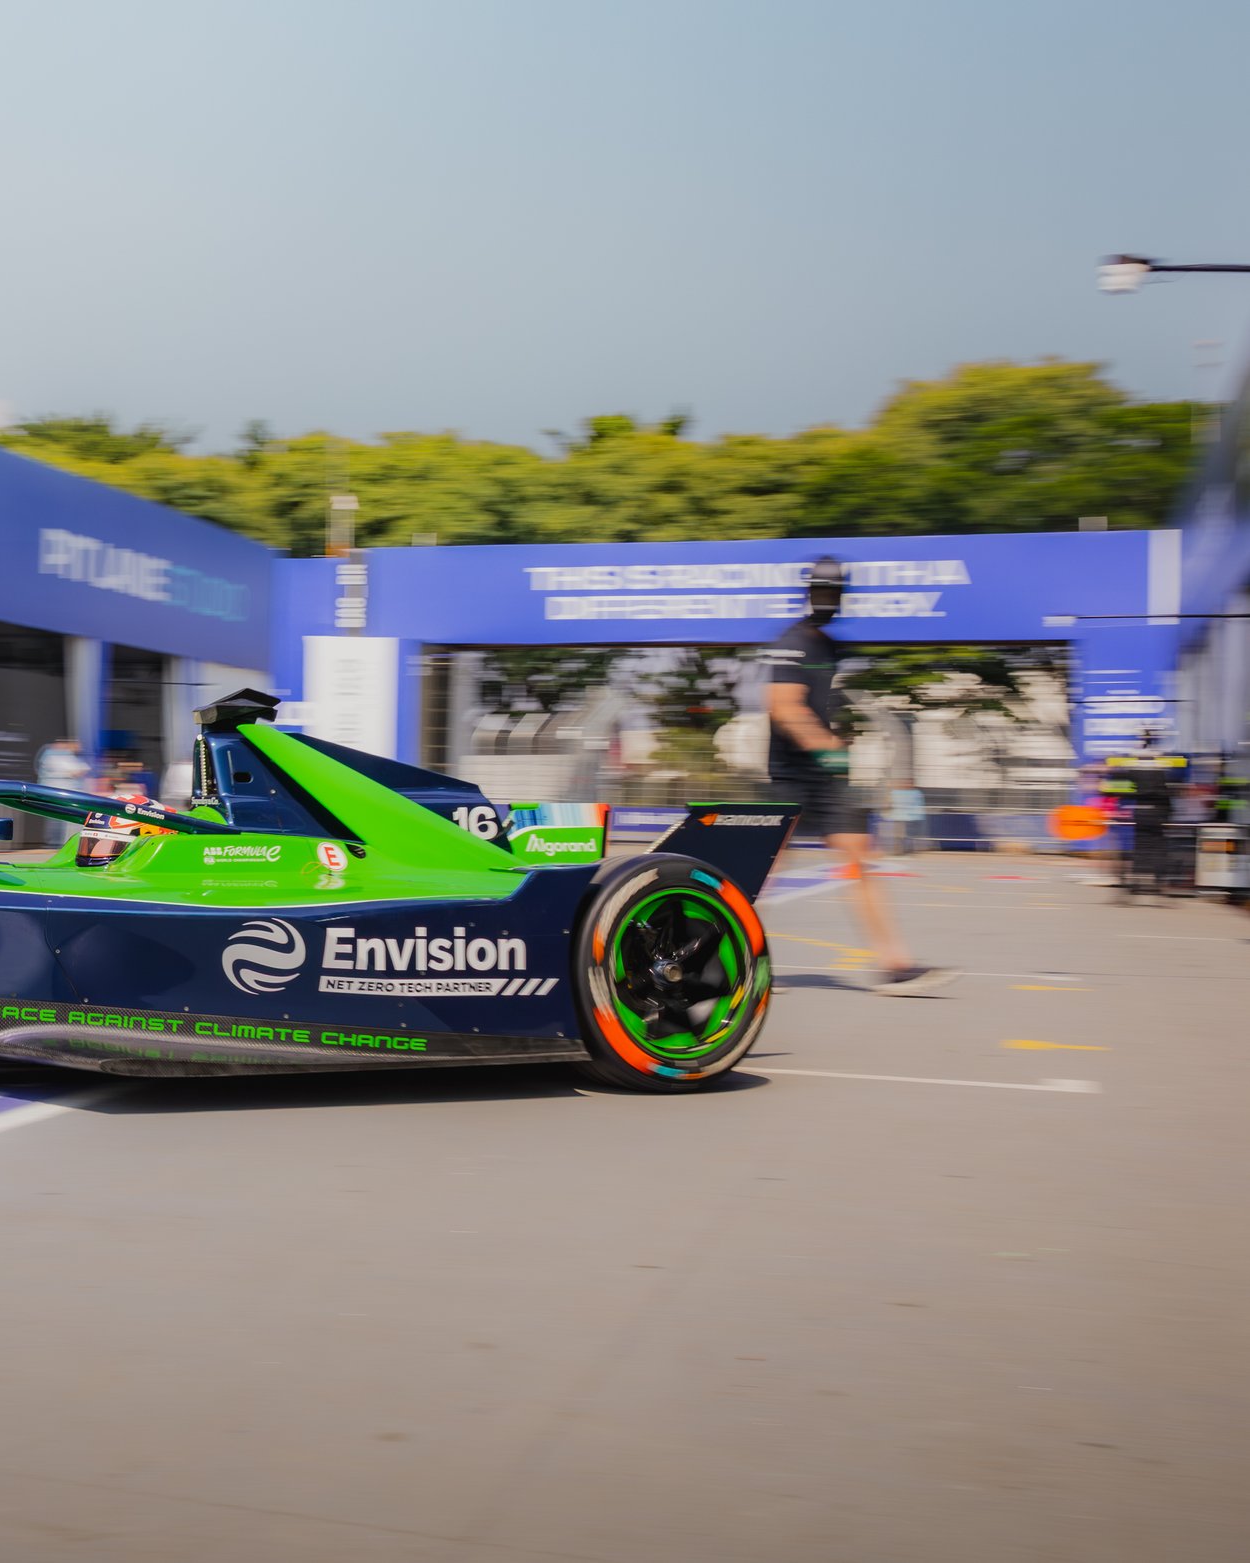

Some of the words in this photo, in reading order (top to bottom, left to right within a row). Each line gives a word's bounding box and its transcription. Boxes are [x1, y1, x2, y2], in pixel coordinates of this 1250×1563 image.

[137, 807, 165, 820] Envision
[452, 806, 499, 841] 16
[324, 846, 341, 866] E
[525, 834, 597, 856] Algorand
[322, 927, 527, 971] Envision
[326, 980, 353, 990] NET
[357, 981, 394, 993] ZERO
[400, 983, 433, 993] TECH
[436, 982, 493, 993] PARTNER
[68, 1011, 183, 1032] AGAINST
[194, 1021, 311, 1043] CLIMATE
[321, 1031, 428, 1051] CHANGE
